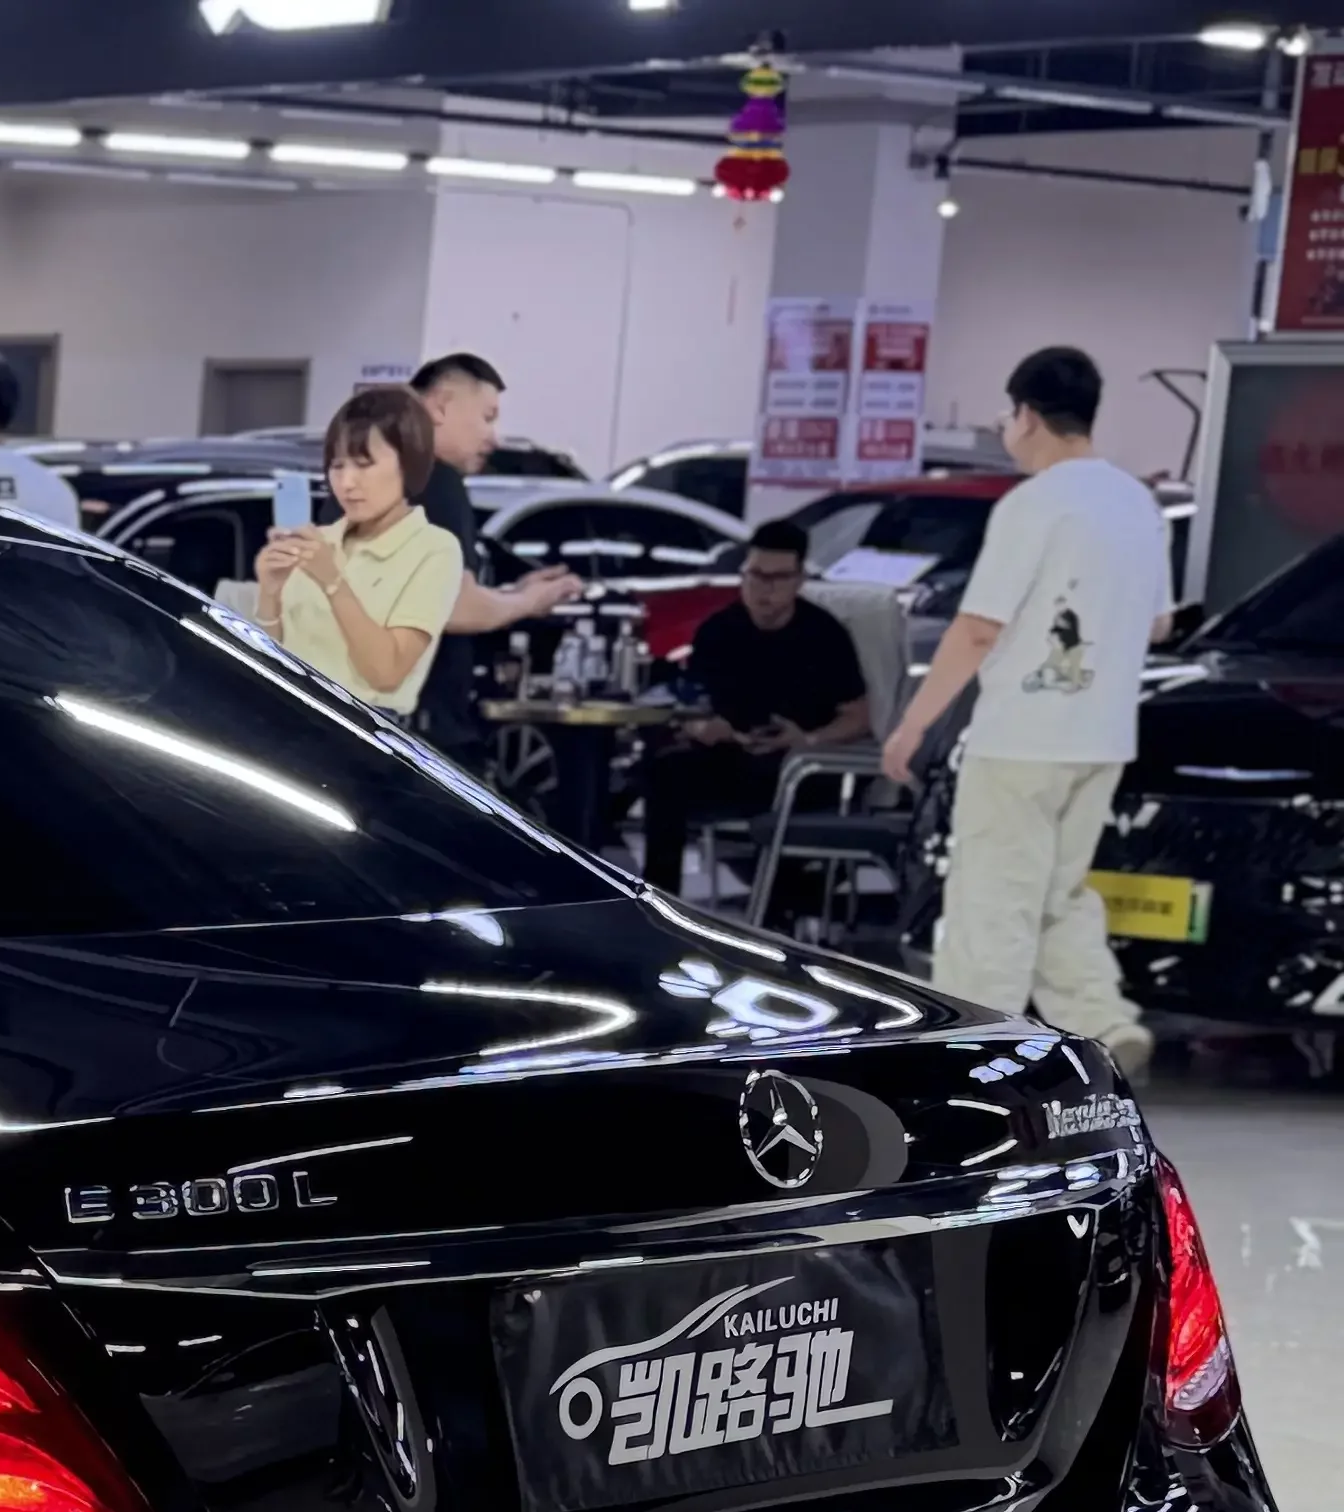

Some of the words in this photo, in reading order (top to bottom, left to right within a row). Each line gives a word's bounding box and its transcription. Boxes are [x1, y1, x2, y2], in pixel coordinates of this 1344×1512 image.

[64, 1185, 115, 1223] E
[129, 1173, 280, 1220] 300
[292, 1170, 338, 1208] L
[723, 1297, 839, 1339] KAILUCHI
[608, 1327, 894, 1466] 凯路驰
